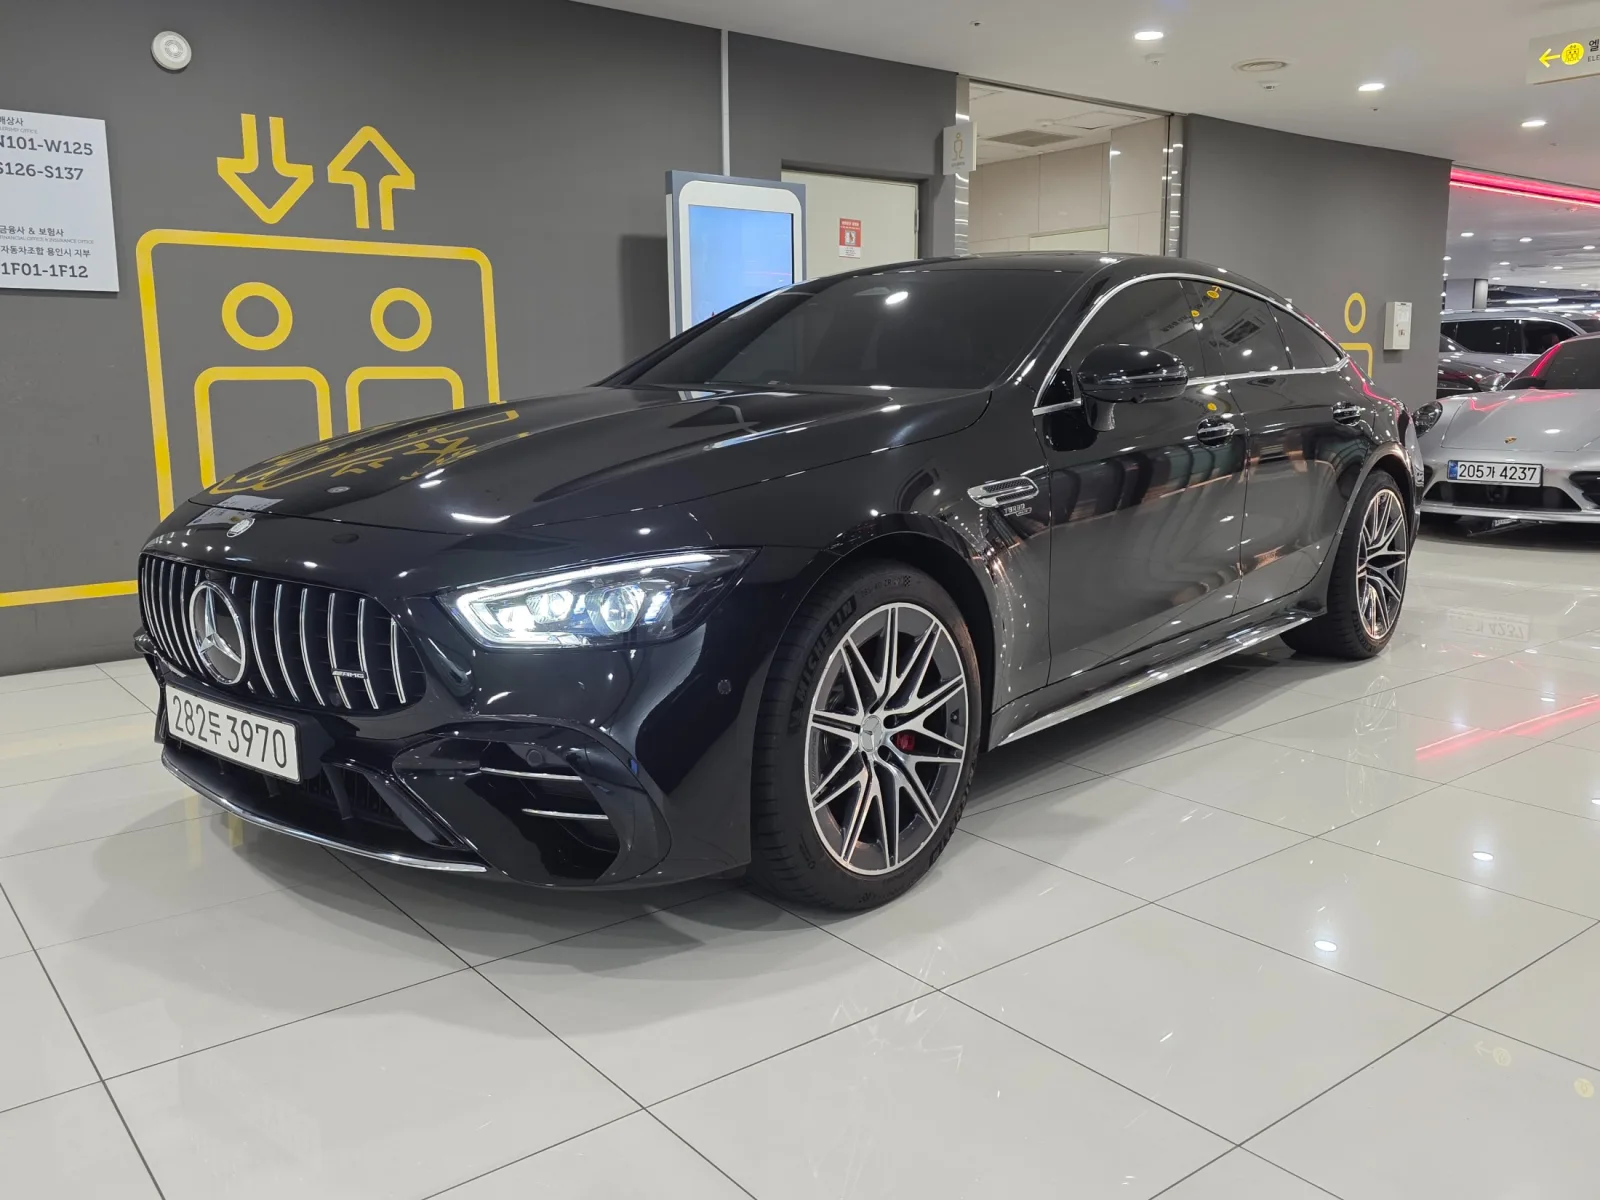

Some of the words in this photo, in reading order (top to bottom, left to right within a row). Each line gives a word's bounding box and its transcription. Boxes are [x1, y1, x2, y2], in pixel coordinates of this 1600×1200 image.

[28, 227, 35, 235] &
[39, 228, 64, 237] 보험사
[47, 247, 72, 257] 용인시
[74, 249, 91, 258] 지부
[1, 262, 88, 278] 1F01-1F12
[1459, 464, 1495, 478] 205가
[1500, 466, 1537, 481] 4237
[796, 595, 857, 702] MICHELIN
[173, 695, 222, 745] 282두
[227, 714, 287, 769] 3970
